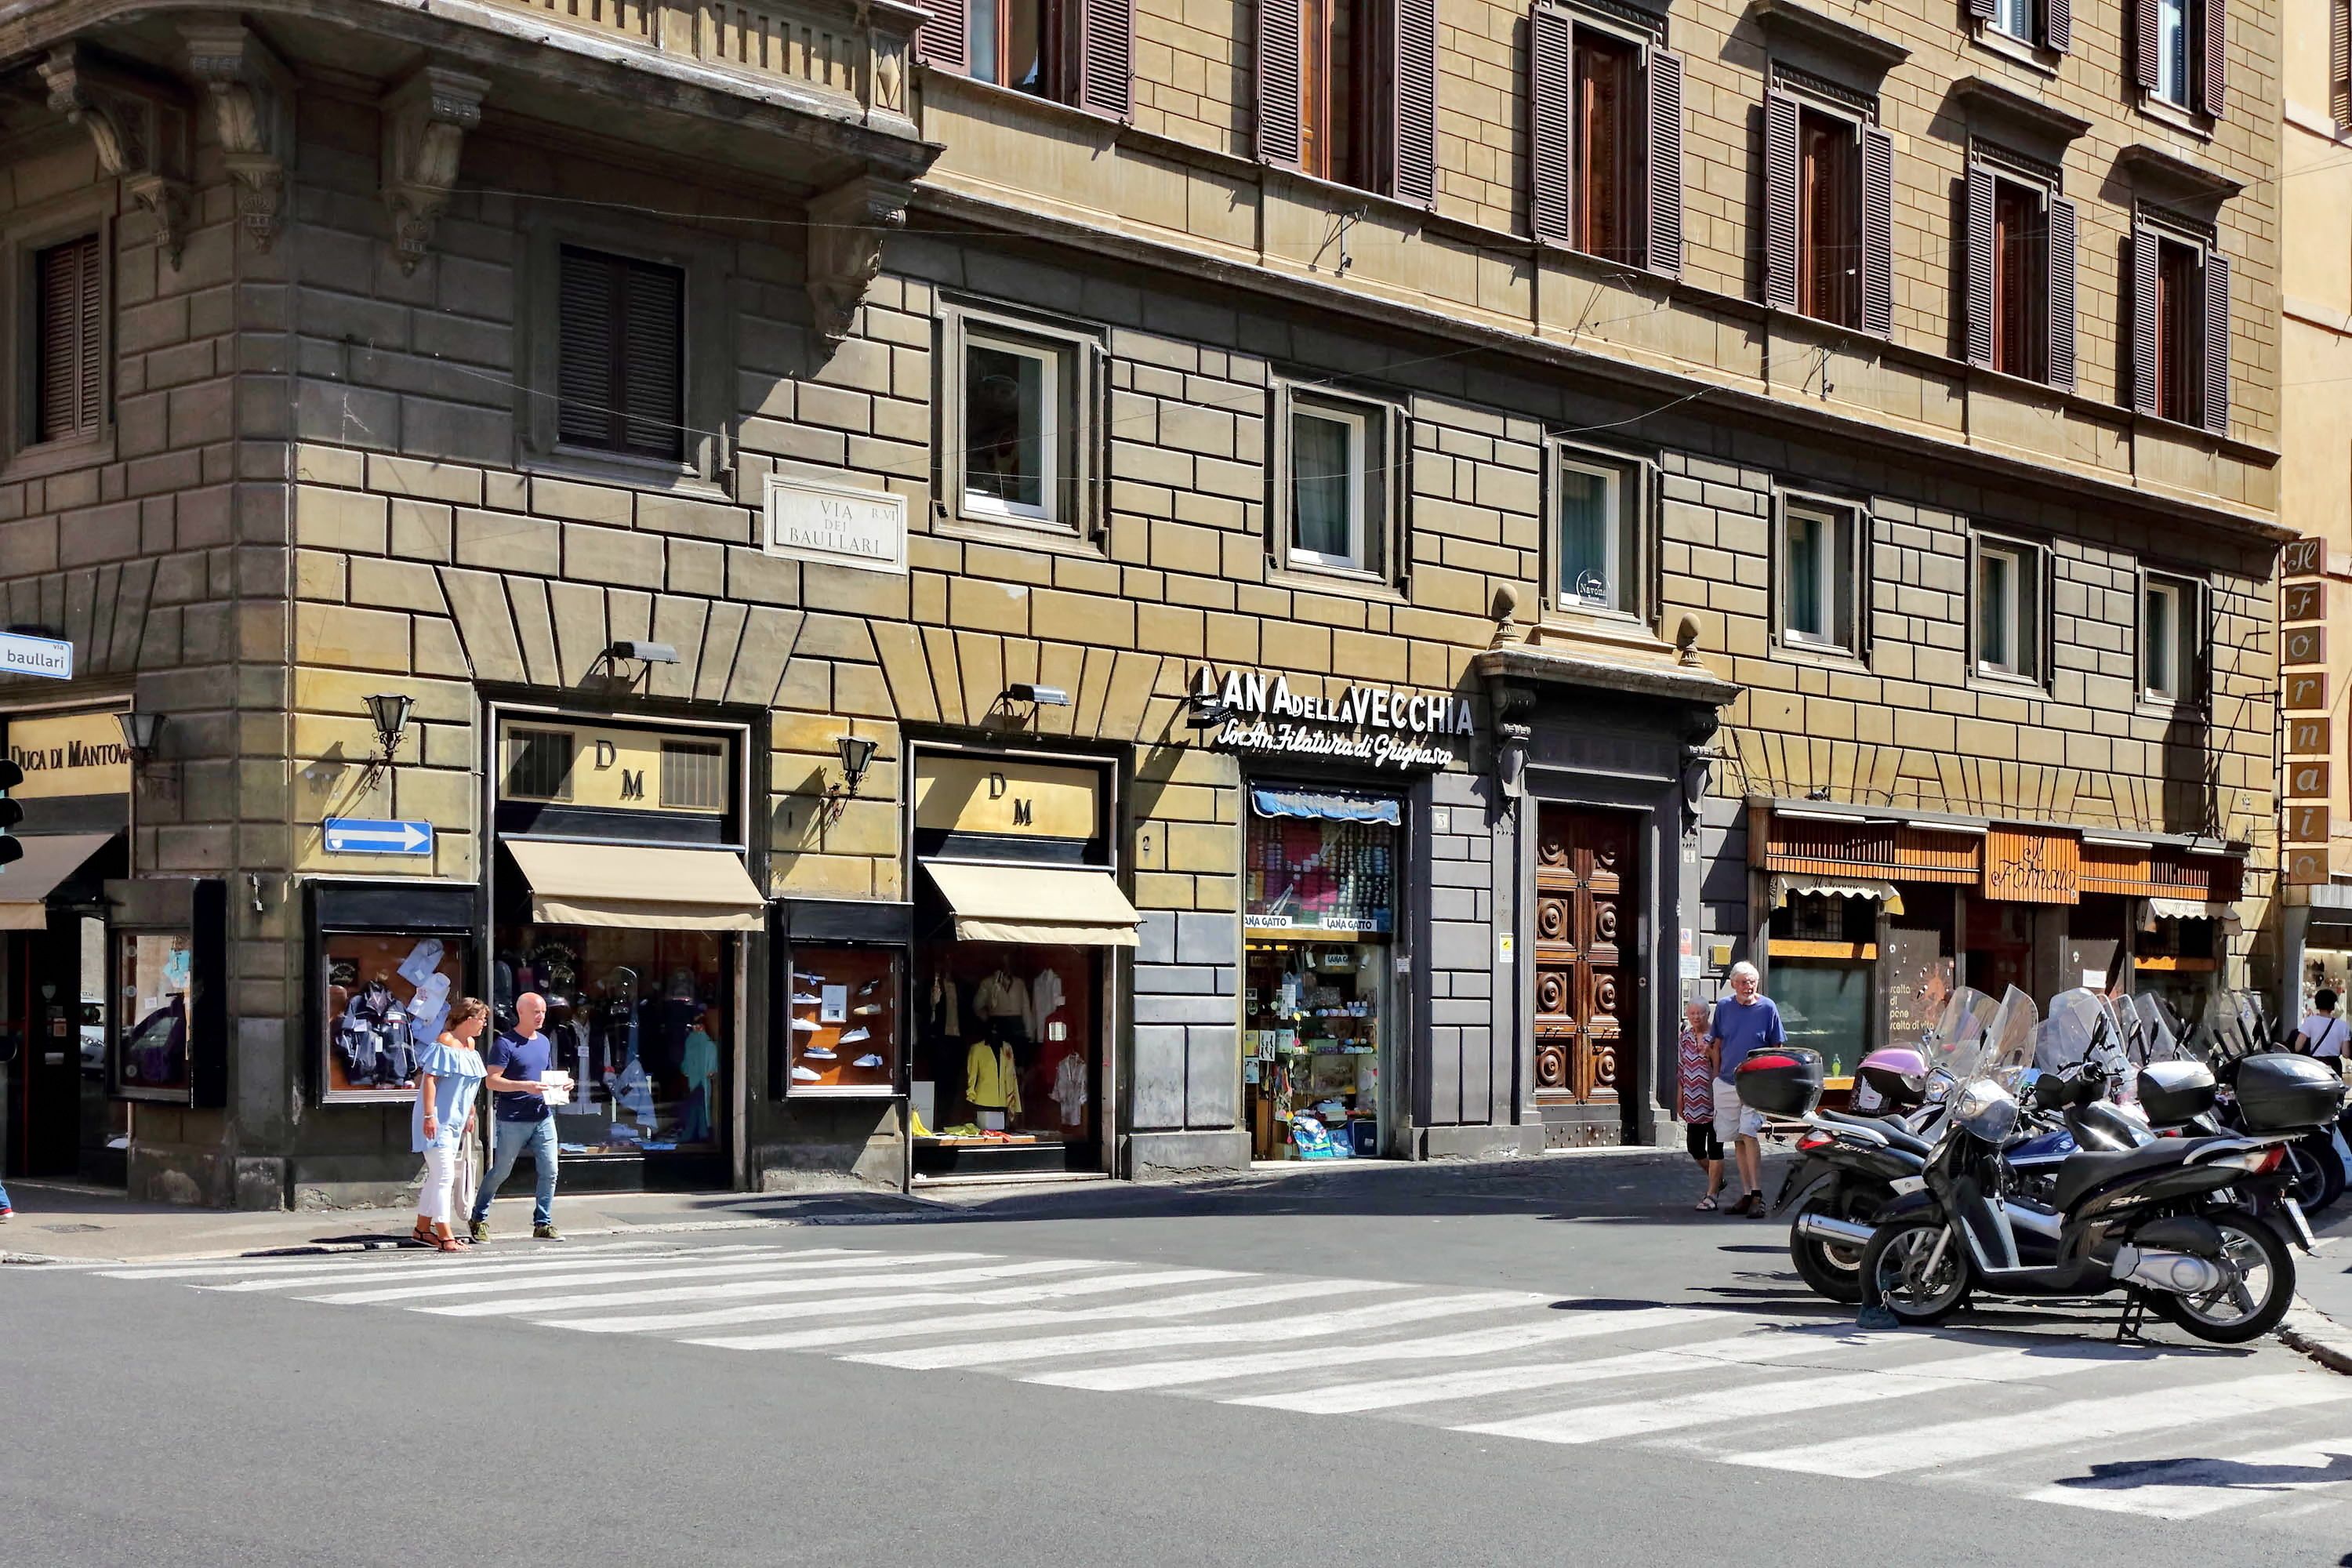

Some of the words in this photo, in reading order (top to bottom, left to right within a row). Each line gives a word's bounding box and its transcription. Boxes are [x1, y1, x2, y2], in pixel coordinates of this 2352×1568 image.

[821, 500, 852, 521] VIA
[825, 519, 846, 532] DEI
[789, 527, 879, 554] BAULLARI
[7, 649, 64, 669] baullari
[1201, 666, 1292, 715] LANA
[1290, 695, 1354, 724] DELLA
[1350, 685, 1474, 736] VECCHIA
[11, 746, 47, 771] DUCA
[50, 748, 64, 769] DI
[67, 740, 131, 768] MANTOV
[595, 739, 617, 768] D
[1276, 724, 1354, 757] Filatura
[1354, 734, 1372, 758] di
[1374, 733, 1454, 771] Grignasco
[621, 768, 645, 797] M
[989, 771, 1007, 799] D
[1013, 798, 1033, 825] M
[1438, 814, 1445, 826] 3
[1142, 835, 1150, 851] 2
[1991, 859, 2075, 891] Fornaio
[1261, 916, 1287, 927] GATTO
[1327, 918, 1346, 929] LANA
[1348, 920, 1372, 930] GATTO
[1890, 996, 1897, 1005] di
[1889, 1021, 1911, 1030] scelta
[1912, 1020, 1919, 1030] di
